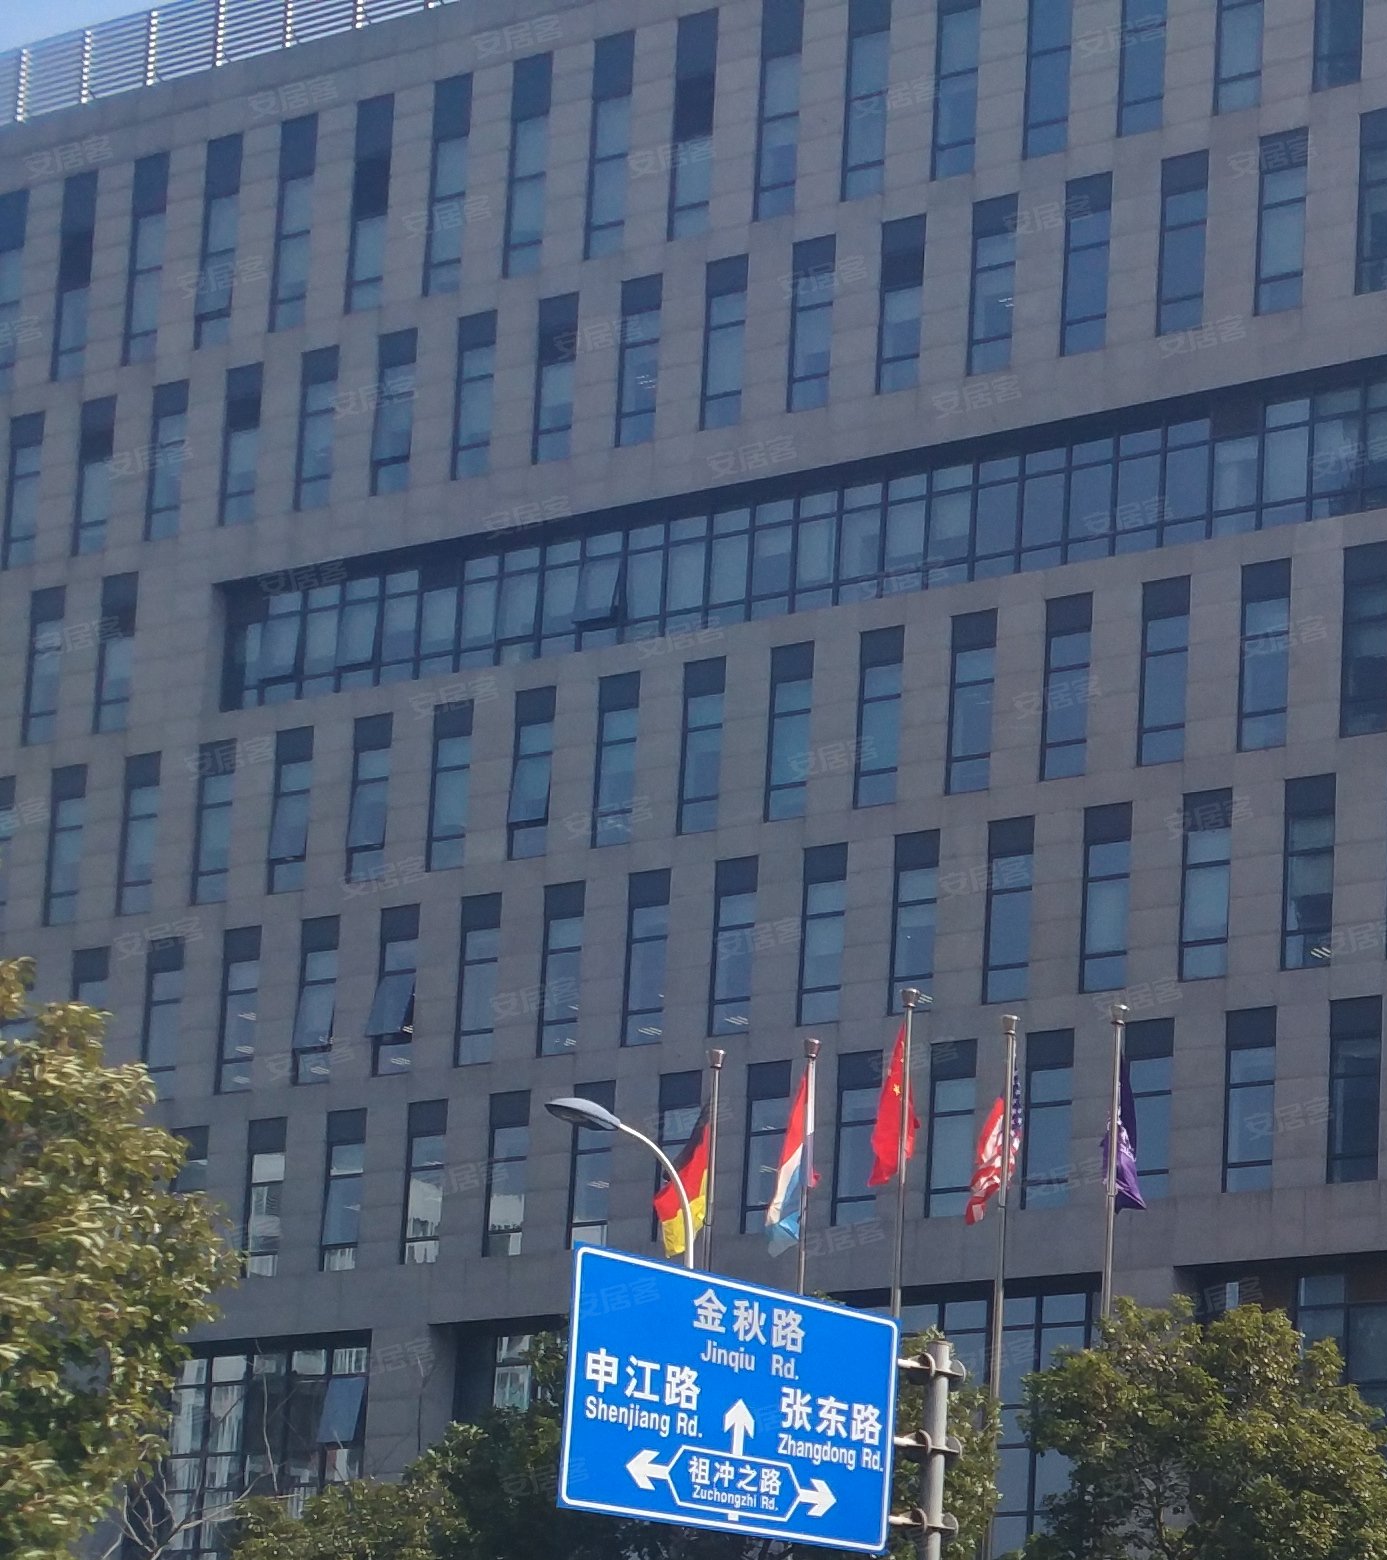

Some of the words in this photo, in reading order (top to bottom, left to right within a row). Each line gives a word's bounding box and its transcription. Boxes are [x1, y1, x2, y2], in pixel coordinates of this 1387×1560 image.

[692, 1289, 806, 1354] 金秋路
[585, 1348, 701, 1411] 申江路
[700, 1340, 756, 1373] Jinqiu
[771, 1353, 799, 1381] Rd.
[585, 1396, 670, 1437] Shenjiang
[676, 1411, 703, 1439] Rd.
[780, 1386, 883, 1446] 张东路
[777, 1433, 856, 1471] Zhangdong
[862, 1449, 884, 1473] Rd.
[688, 1455, 783, 1495] 祖冲之路
[692, 1484, 757, 1509] Zuchongzhi
[760, 1491, 779, 1511] Rd.
